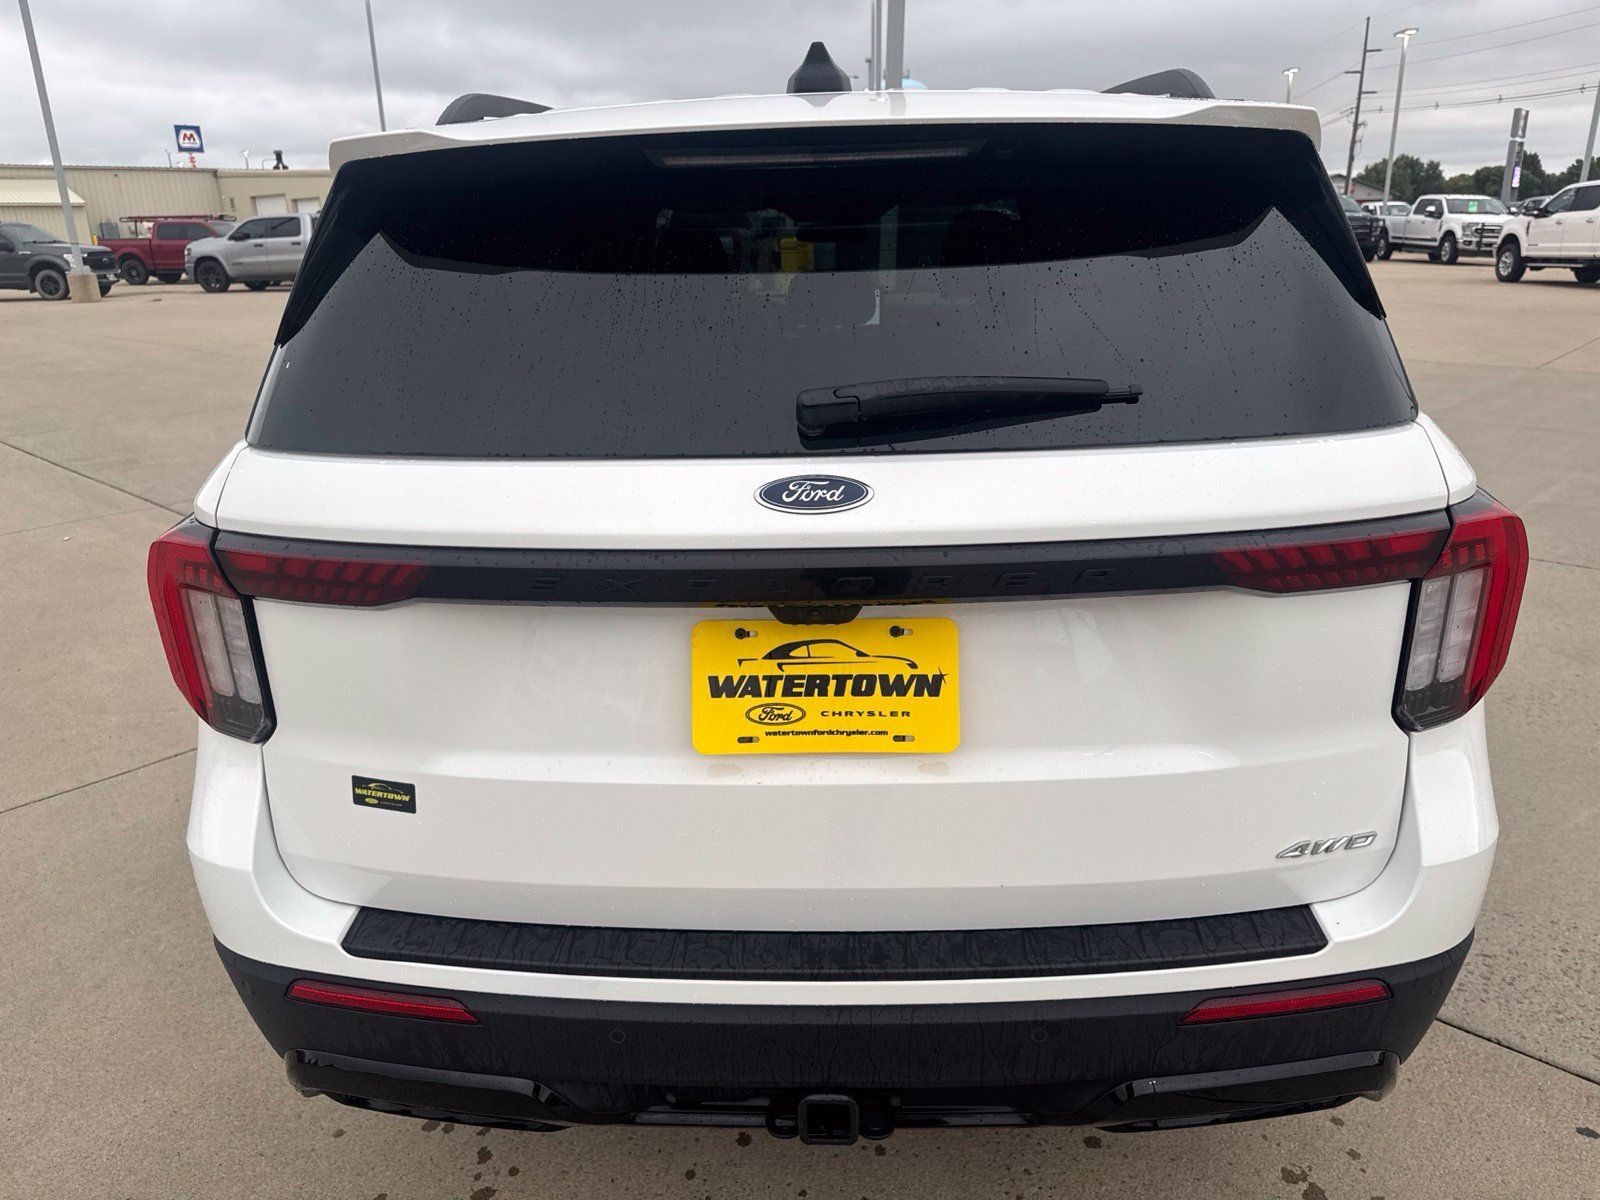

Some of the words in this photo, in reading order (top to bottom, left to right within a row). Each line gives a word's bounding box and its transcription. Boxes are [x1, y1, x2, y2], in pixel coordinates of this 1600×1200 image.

[182, 132, 197, 142] M
[781, 480, 846, 502] Ford
[707, 673, 943, 698] WATERTOWN
[757, 706, 794, 723] Ford
[820, 710, 911, 718] CHRYSLER
[764, 728, 888, 737] watertownfordchrysler.com
[354, 787, 411, 802] WATERTOWN
[1276, 830, 1377, 859] 4WD
